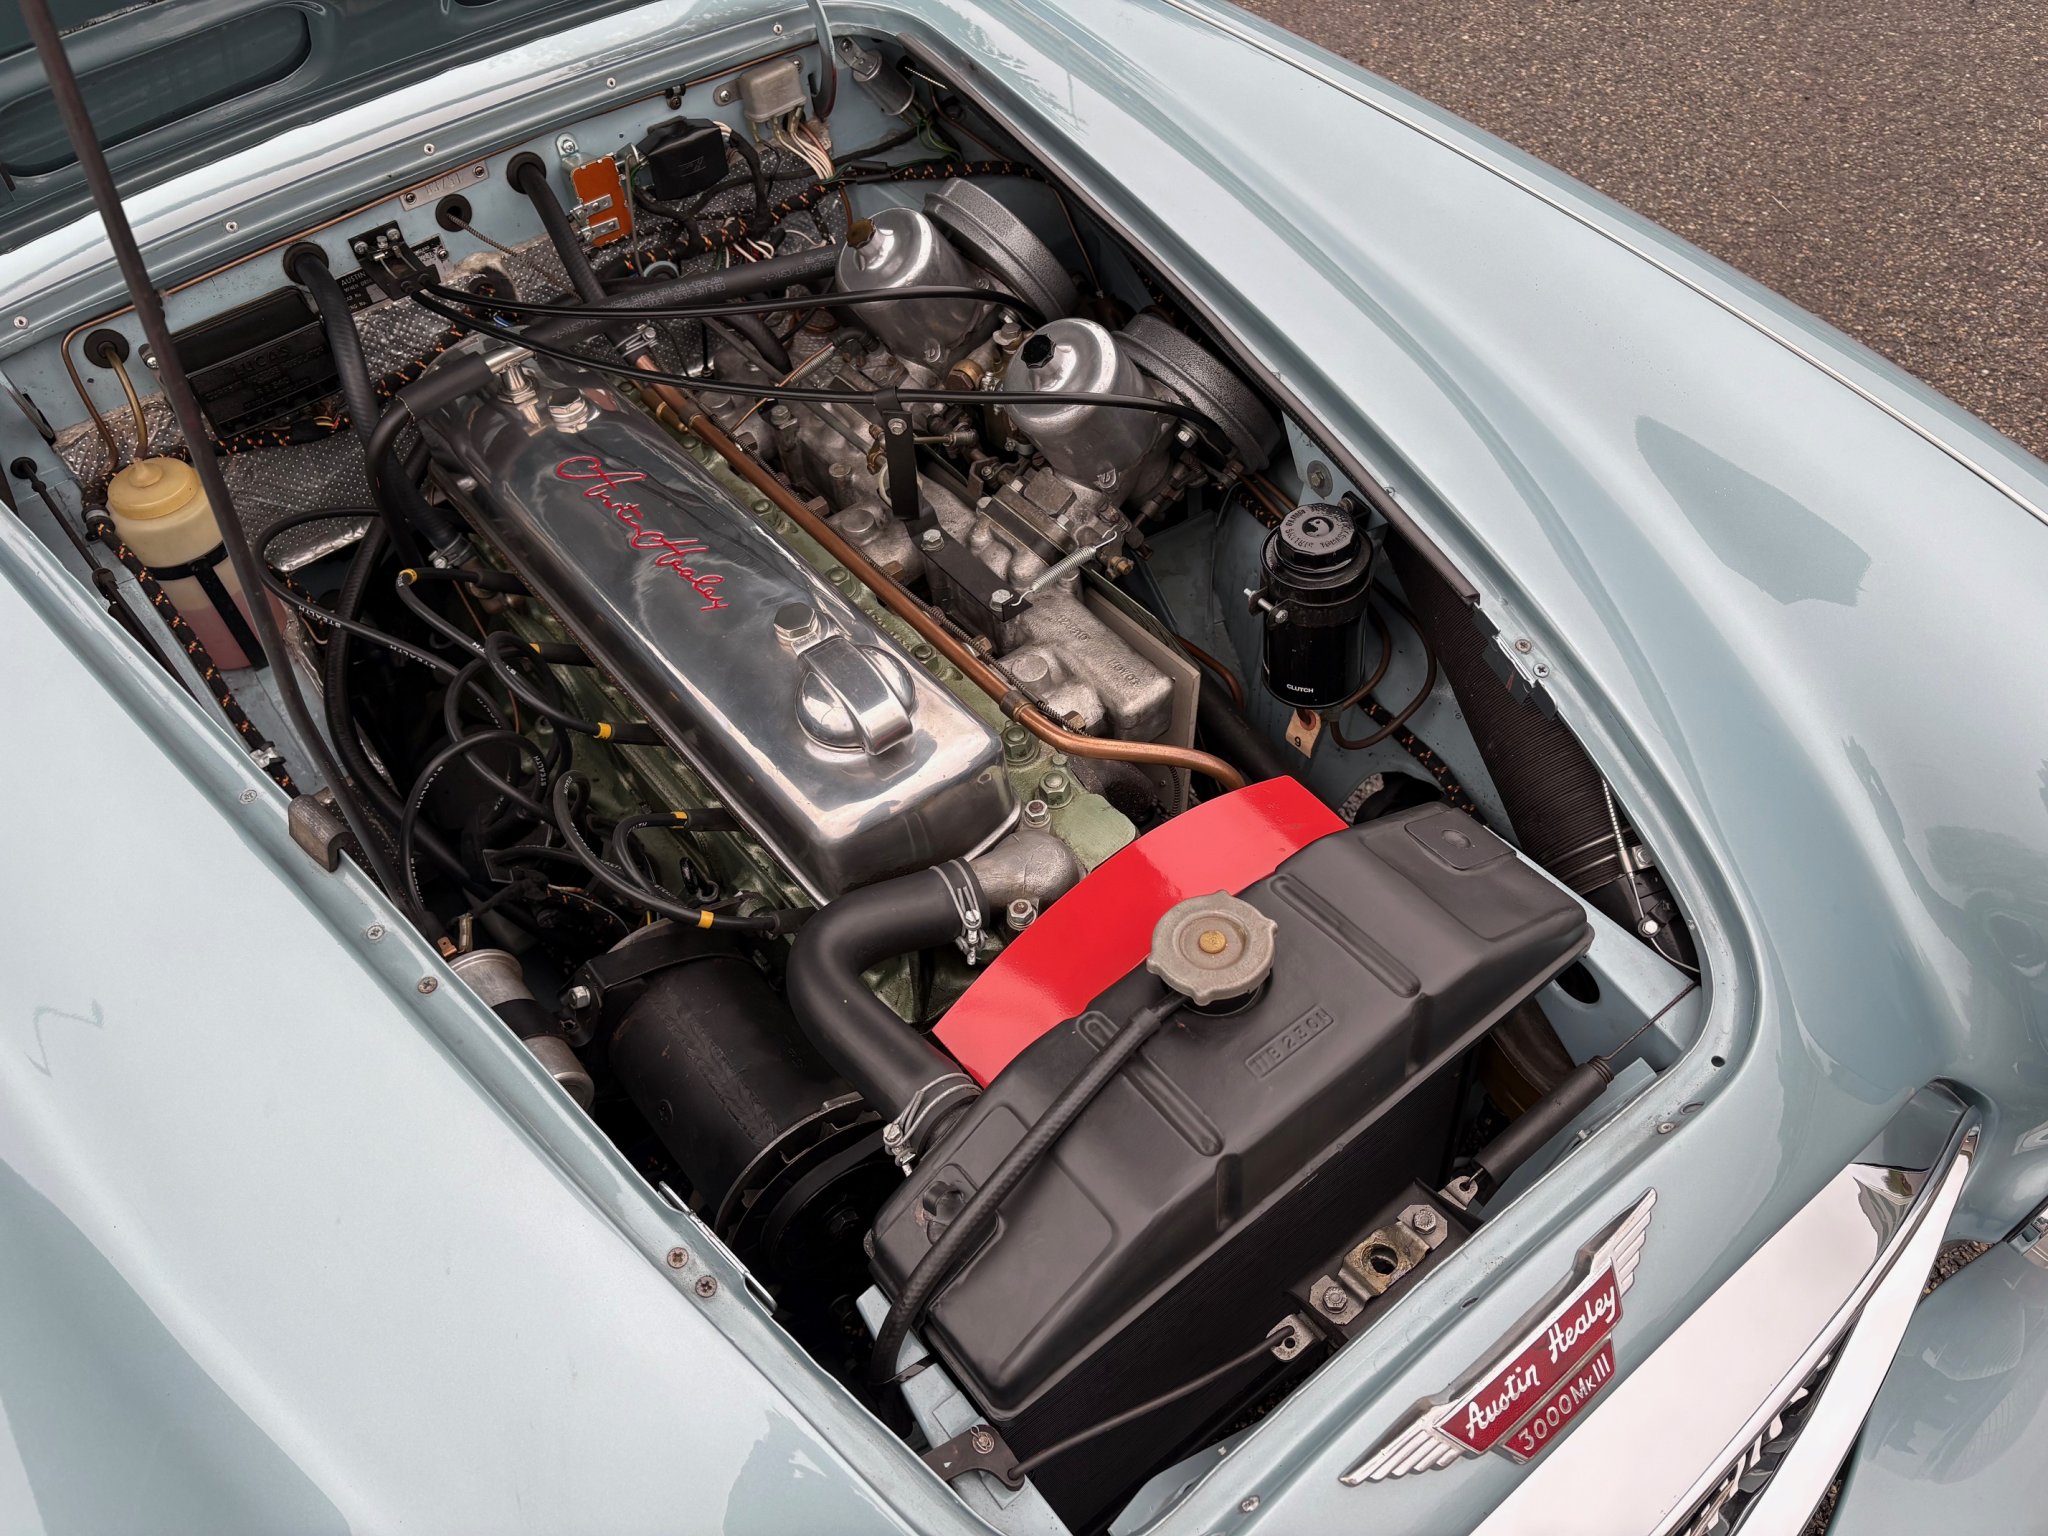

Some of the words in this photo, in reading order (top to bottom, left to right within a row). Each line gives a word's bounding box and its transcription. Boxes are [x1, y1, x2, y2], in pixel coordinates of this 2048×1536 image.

[341, 271, 367, 287] AUSTIN
[298, 605, 342, 629] STEALTH
[389, 644, 437, 670] STEALTH
[1286, 683, 1314, 694] CLUTCH
[1465, 1363, 1541, 1439] Austin
[1548, 1285, 1616, 1365] Healey
